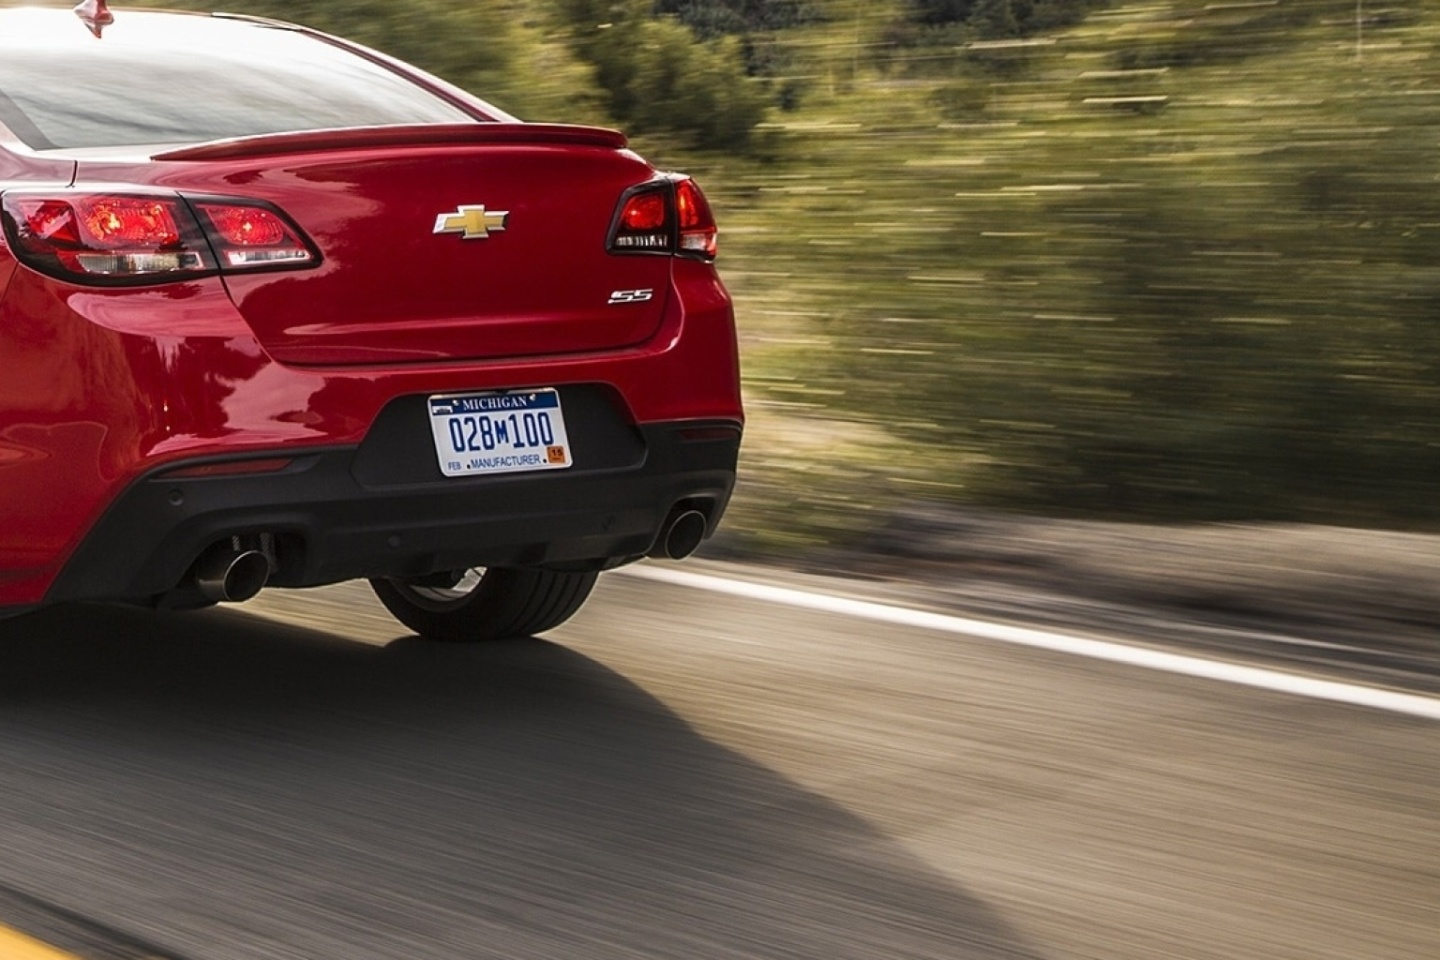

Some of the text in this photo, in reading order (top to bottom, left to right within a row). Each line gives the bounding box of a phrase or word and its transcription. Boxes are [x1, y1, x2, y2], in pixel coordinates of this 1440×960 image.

[607, 288, 653, 304] SS
[462, 395, 527, 410] MICHIGAN
[449, 412, 554, 452] 028M100
[448, 461, 461, 471] FEB
[470, 454, 541, 468] MANUFACTURER
